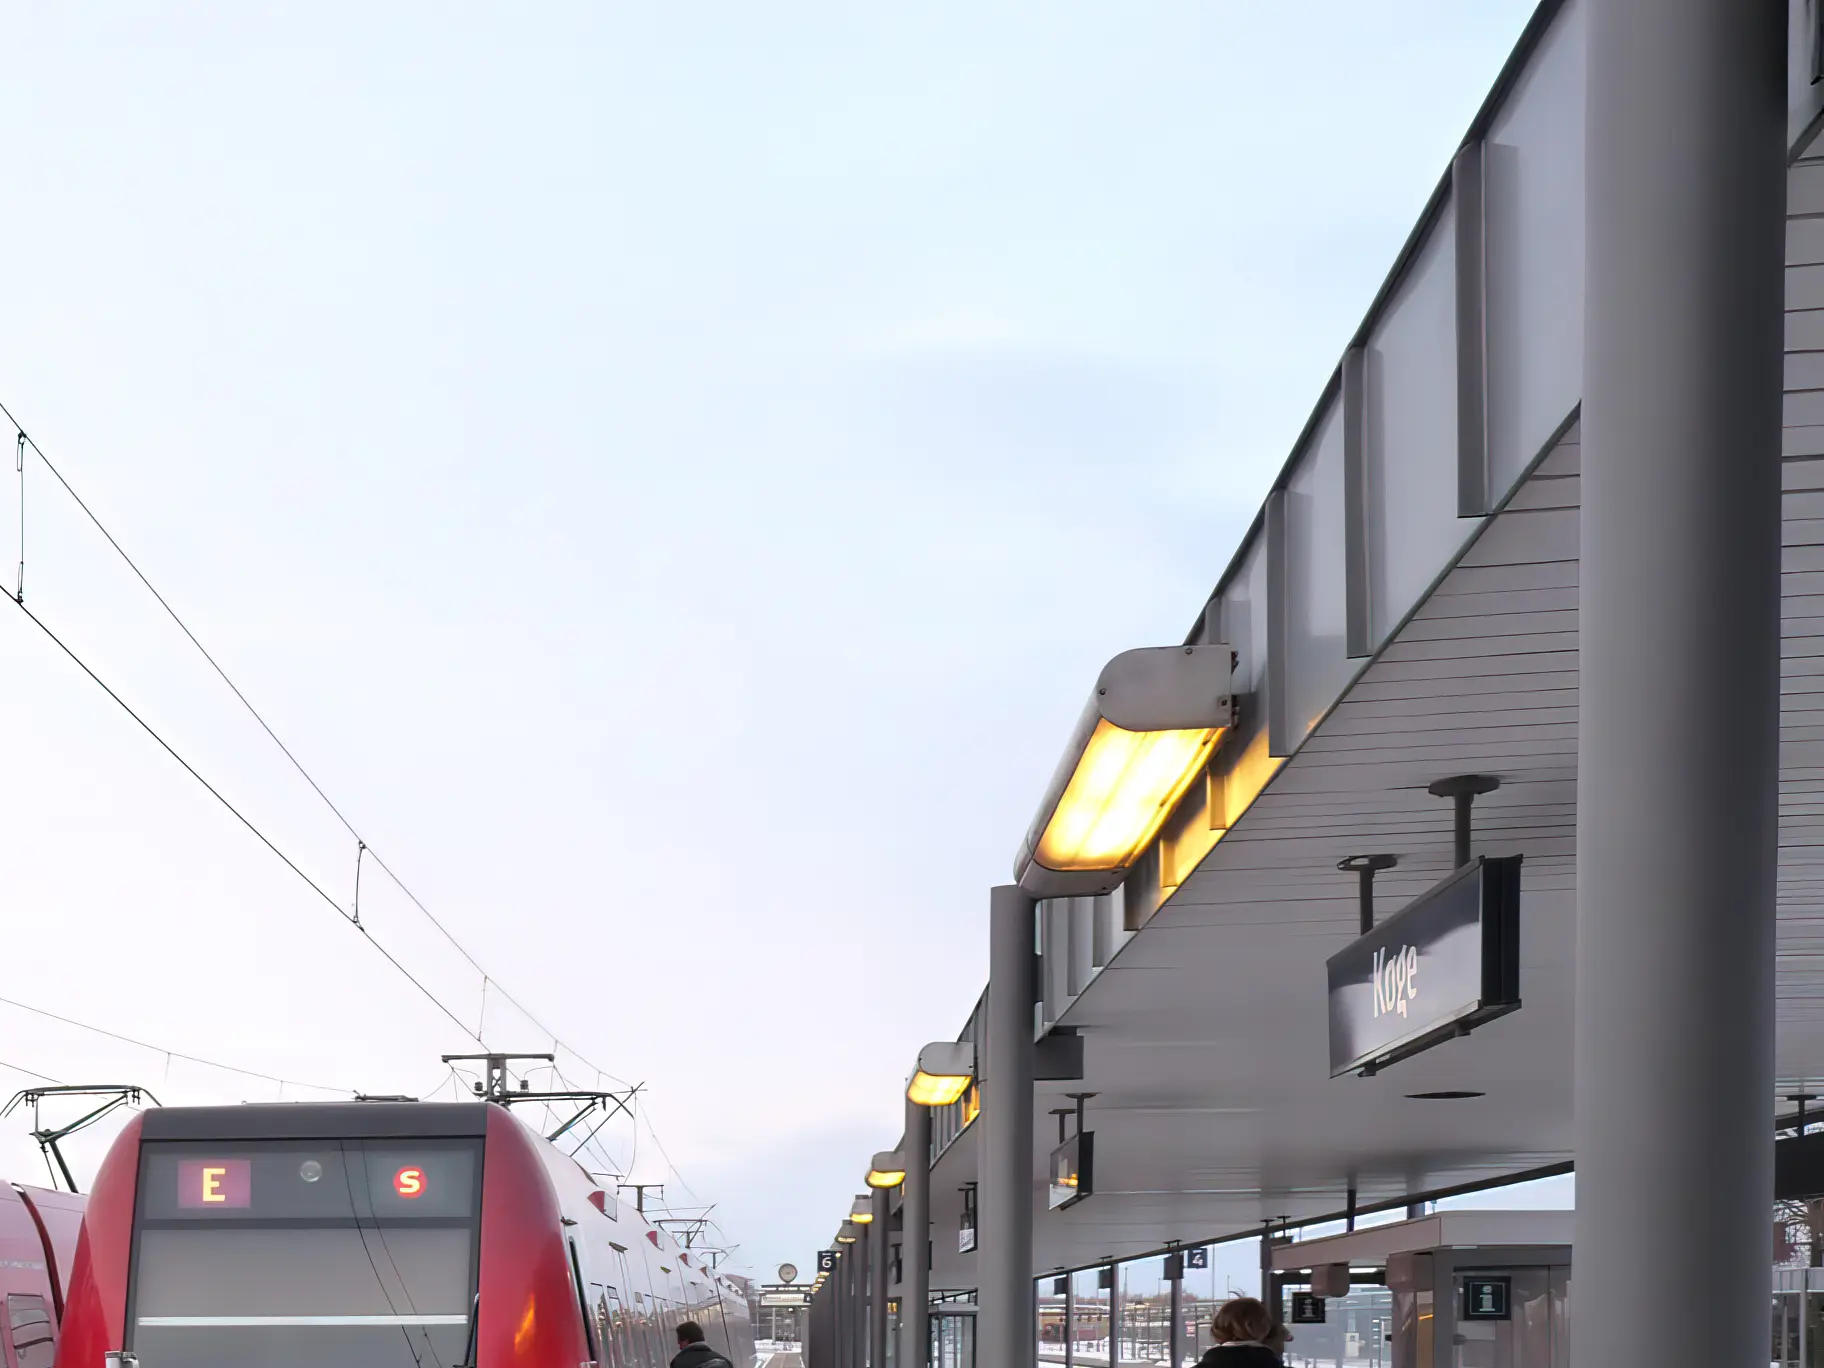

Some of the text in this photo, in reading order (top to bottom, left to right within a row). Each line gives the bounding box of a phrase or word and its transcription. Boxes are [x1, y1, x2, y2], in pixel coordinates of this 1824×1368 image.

[202, 1168, 226, 1201] E
[399, 1170, 421, 1193] S
[822, 1256, 832, 1268] 6
